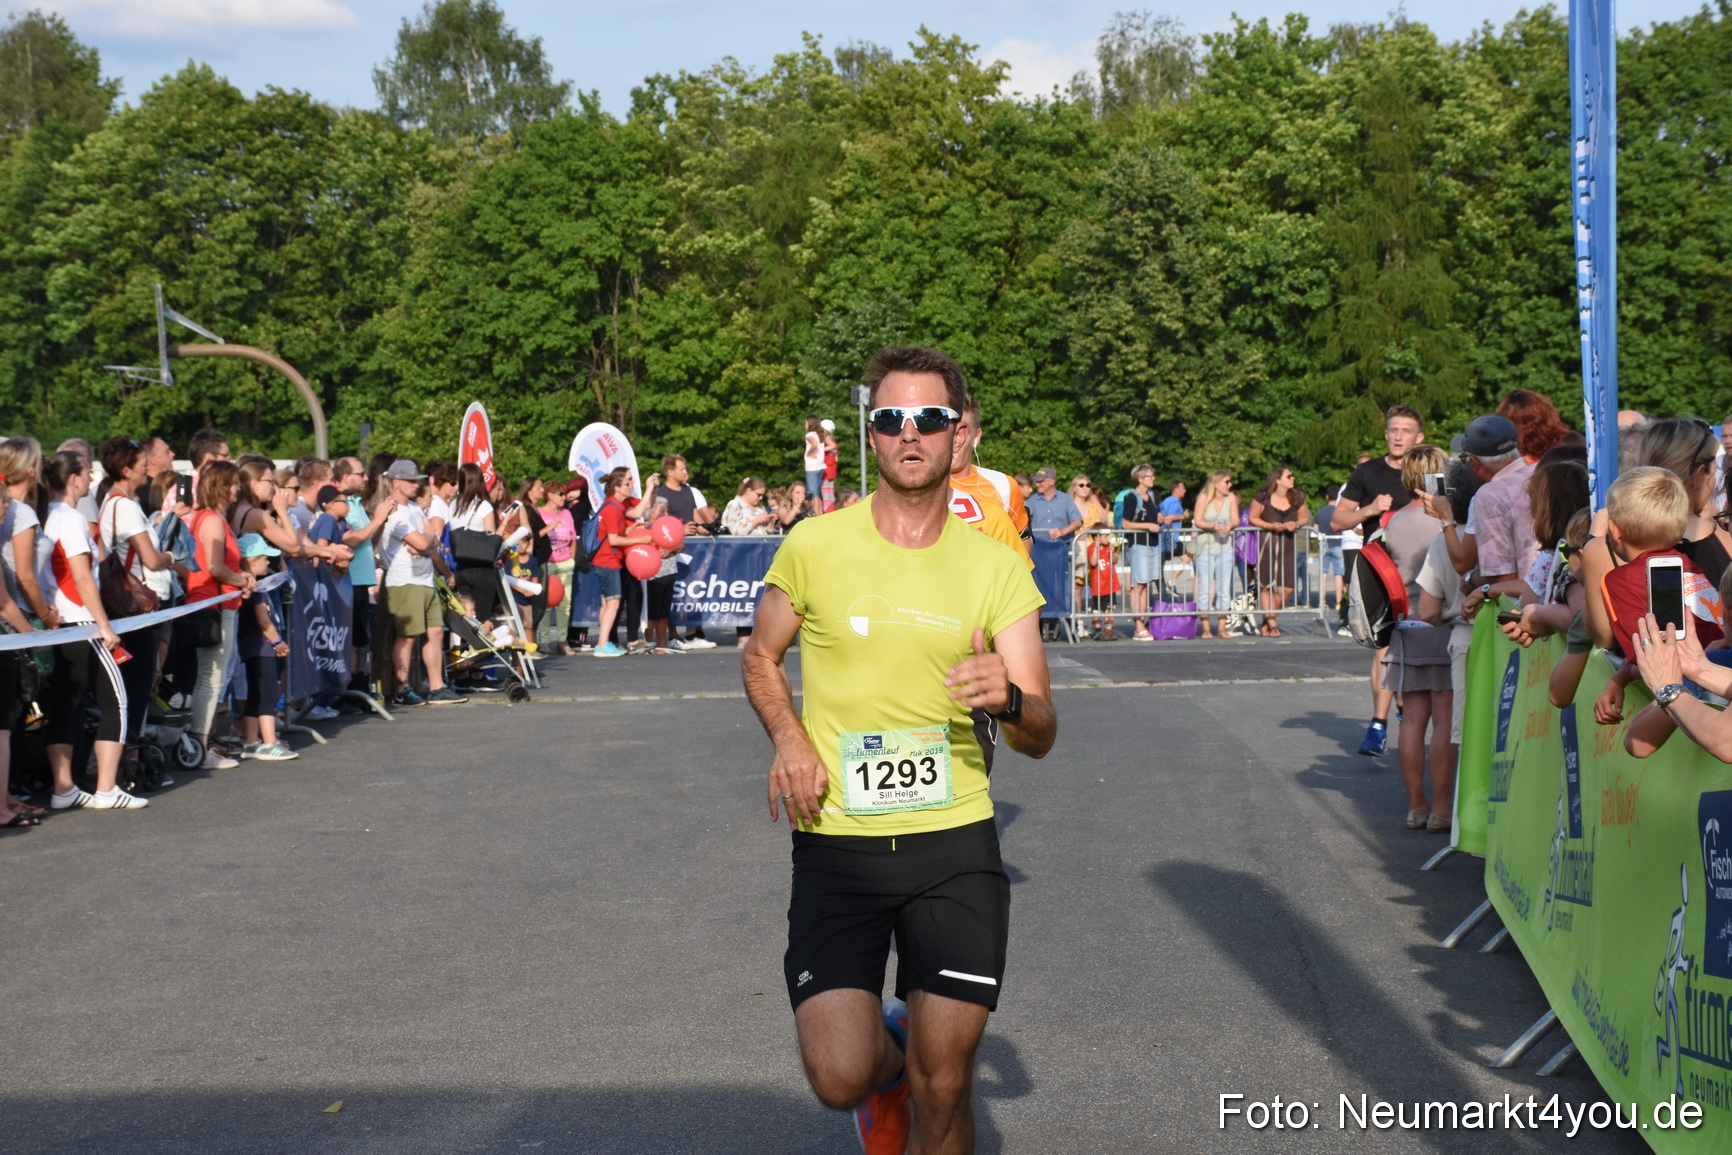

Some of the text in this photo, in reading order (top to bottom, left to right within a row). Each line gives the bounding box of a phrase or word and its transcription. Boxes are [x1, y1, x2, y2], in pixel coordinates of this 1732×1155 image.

[673, 574, 765, 598] scher
[670, 602, 754, 612] TOMOBILE
[857, 746, 900, 756] firmenlauf
[925, 747, 944, 756] 2019
[856, 757, 938, 791] 1293
[879, 790, 919, 799] Sill Helge
[898, 797, 925, 805] Neumarkt
[1710, 848, 1732, 880] Fisch
[1690, 1071, 1732, 1112] neumark
